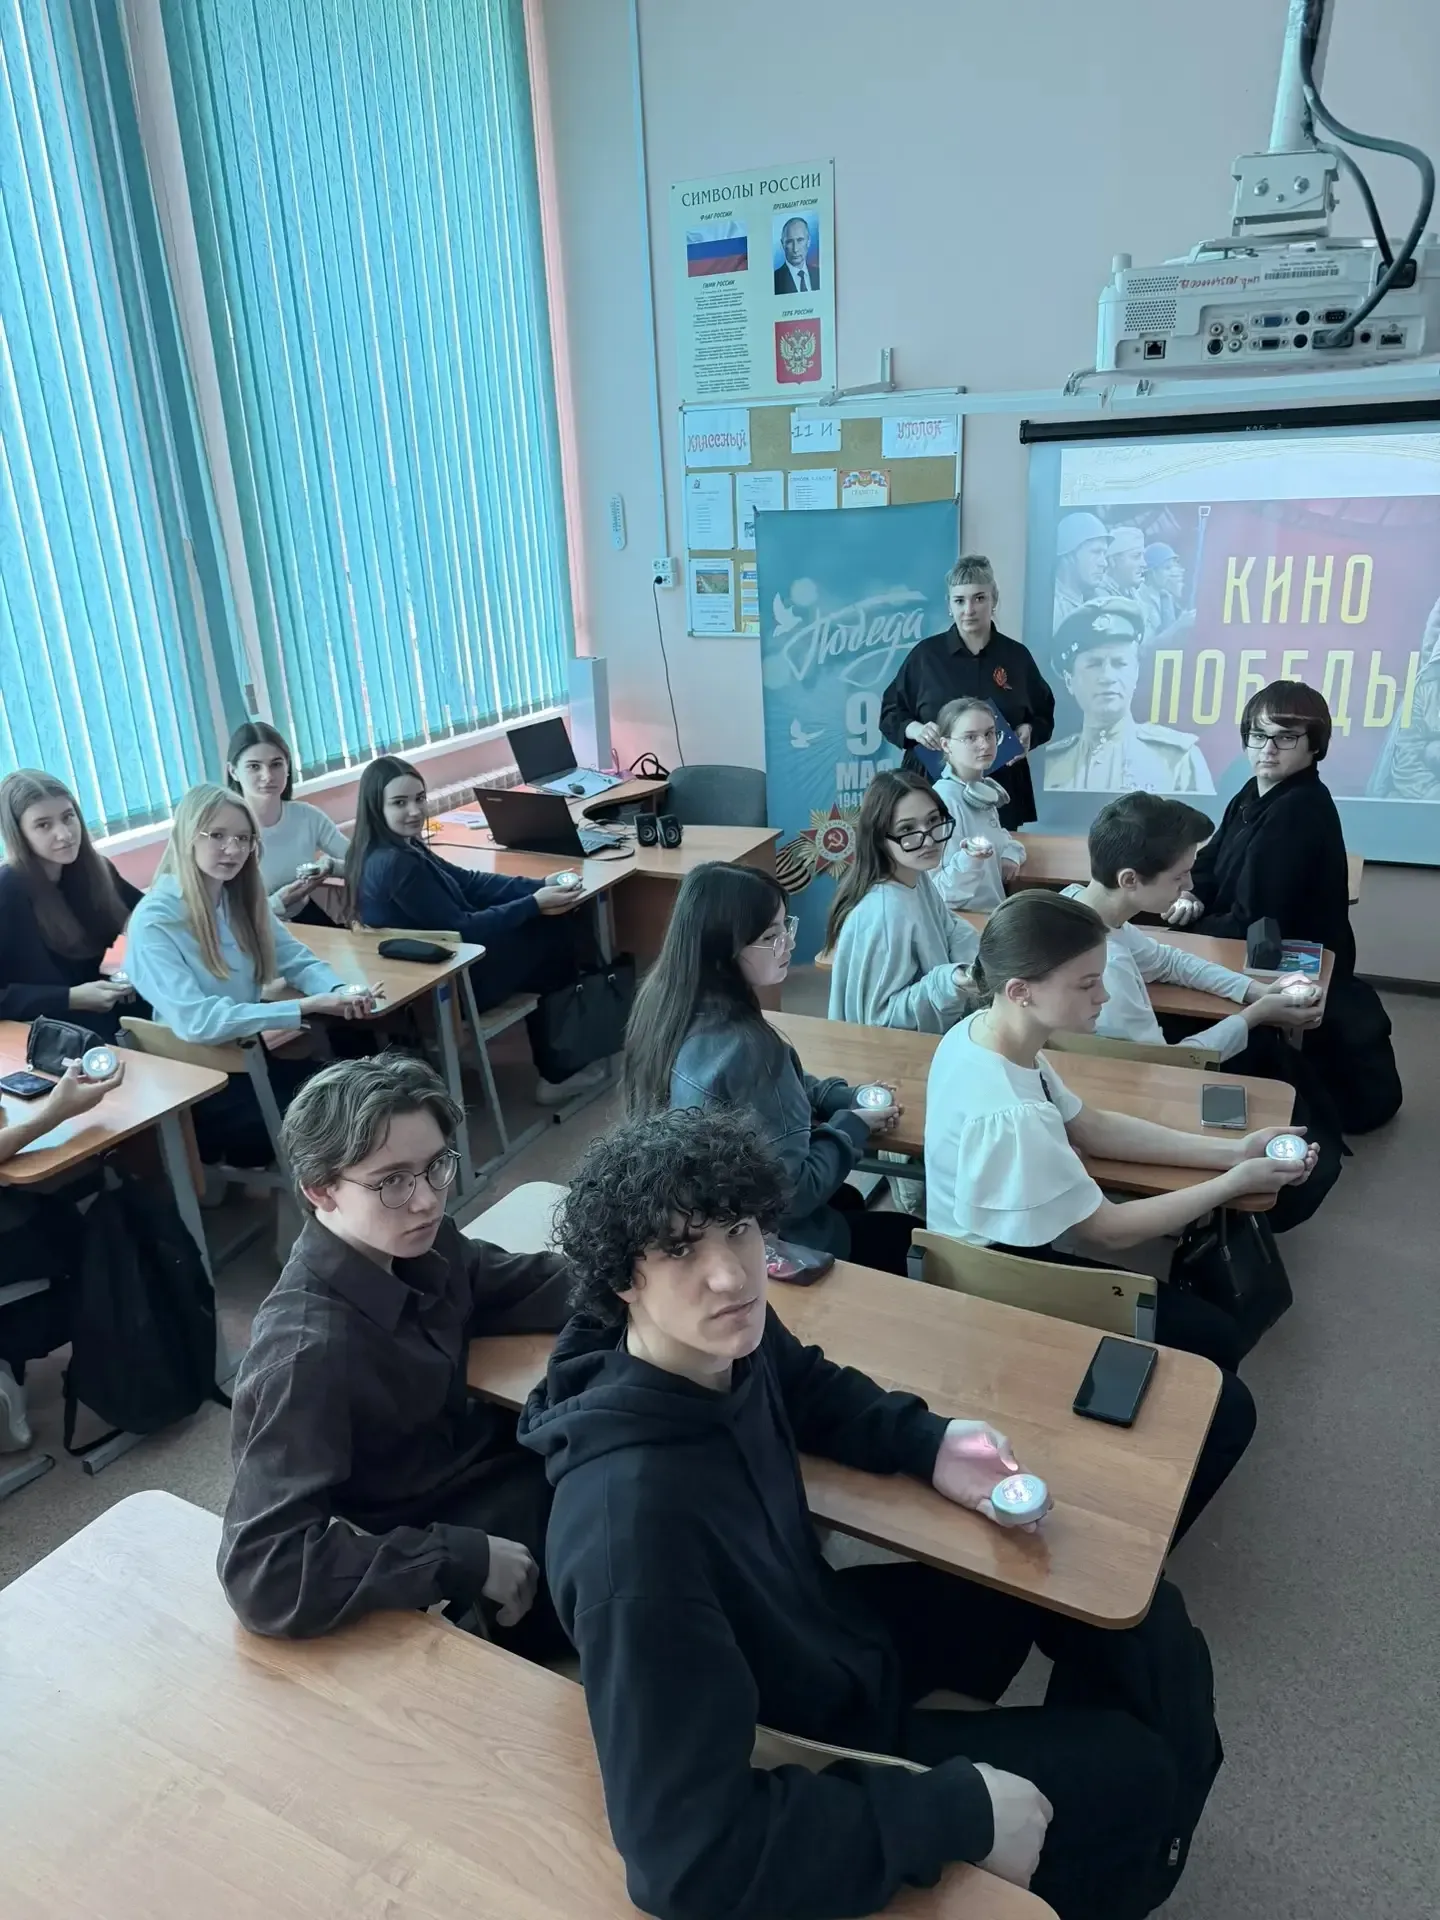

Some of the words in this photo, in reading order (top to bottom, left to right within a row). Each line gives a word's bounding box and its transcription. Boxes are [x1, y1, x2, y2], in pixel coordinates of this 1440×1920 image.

[681, 182, 754, 207] СИМВОЛЫ
[759, 172, 821, 196] РОССИИ
[773, 200, 799, 210] ПРЕЗИДЕНТ
[799, 198, 819, 206] РОССИИ
[700, 213, 714, 221] ФЛАГ
[713, 210, 733, 219] РОССИИ
[716, 279, 736, 287] РОССИИ
[793, 308, 815, 316] РОССИИ
[793, 424, 814, 438] 11
[820, 422, 833, 437] И
[896, 419, 942, 440] УГОЛОК
[687, 429, 747, 453] КЛАССНЫЙ
[1223, 554, 1374, 624] КИНО
[783, 590, 929, 688] Победа
[845, 691, 883, 756] 9
[1111, 1285, 1125, 1297] 2
